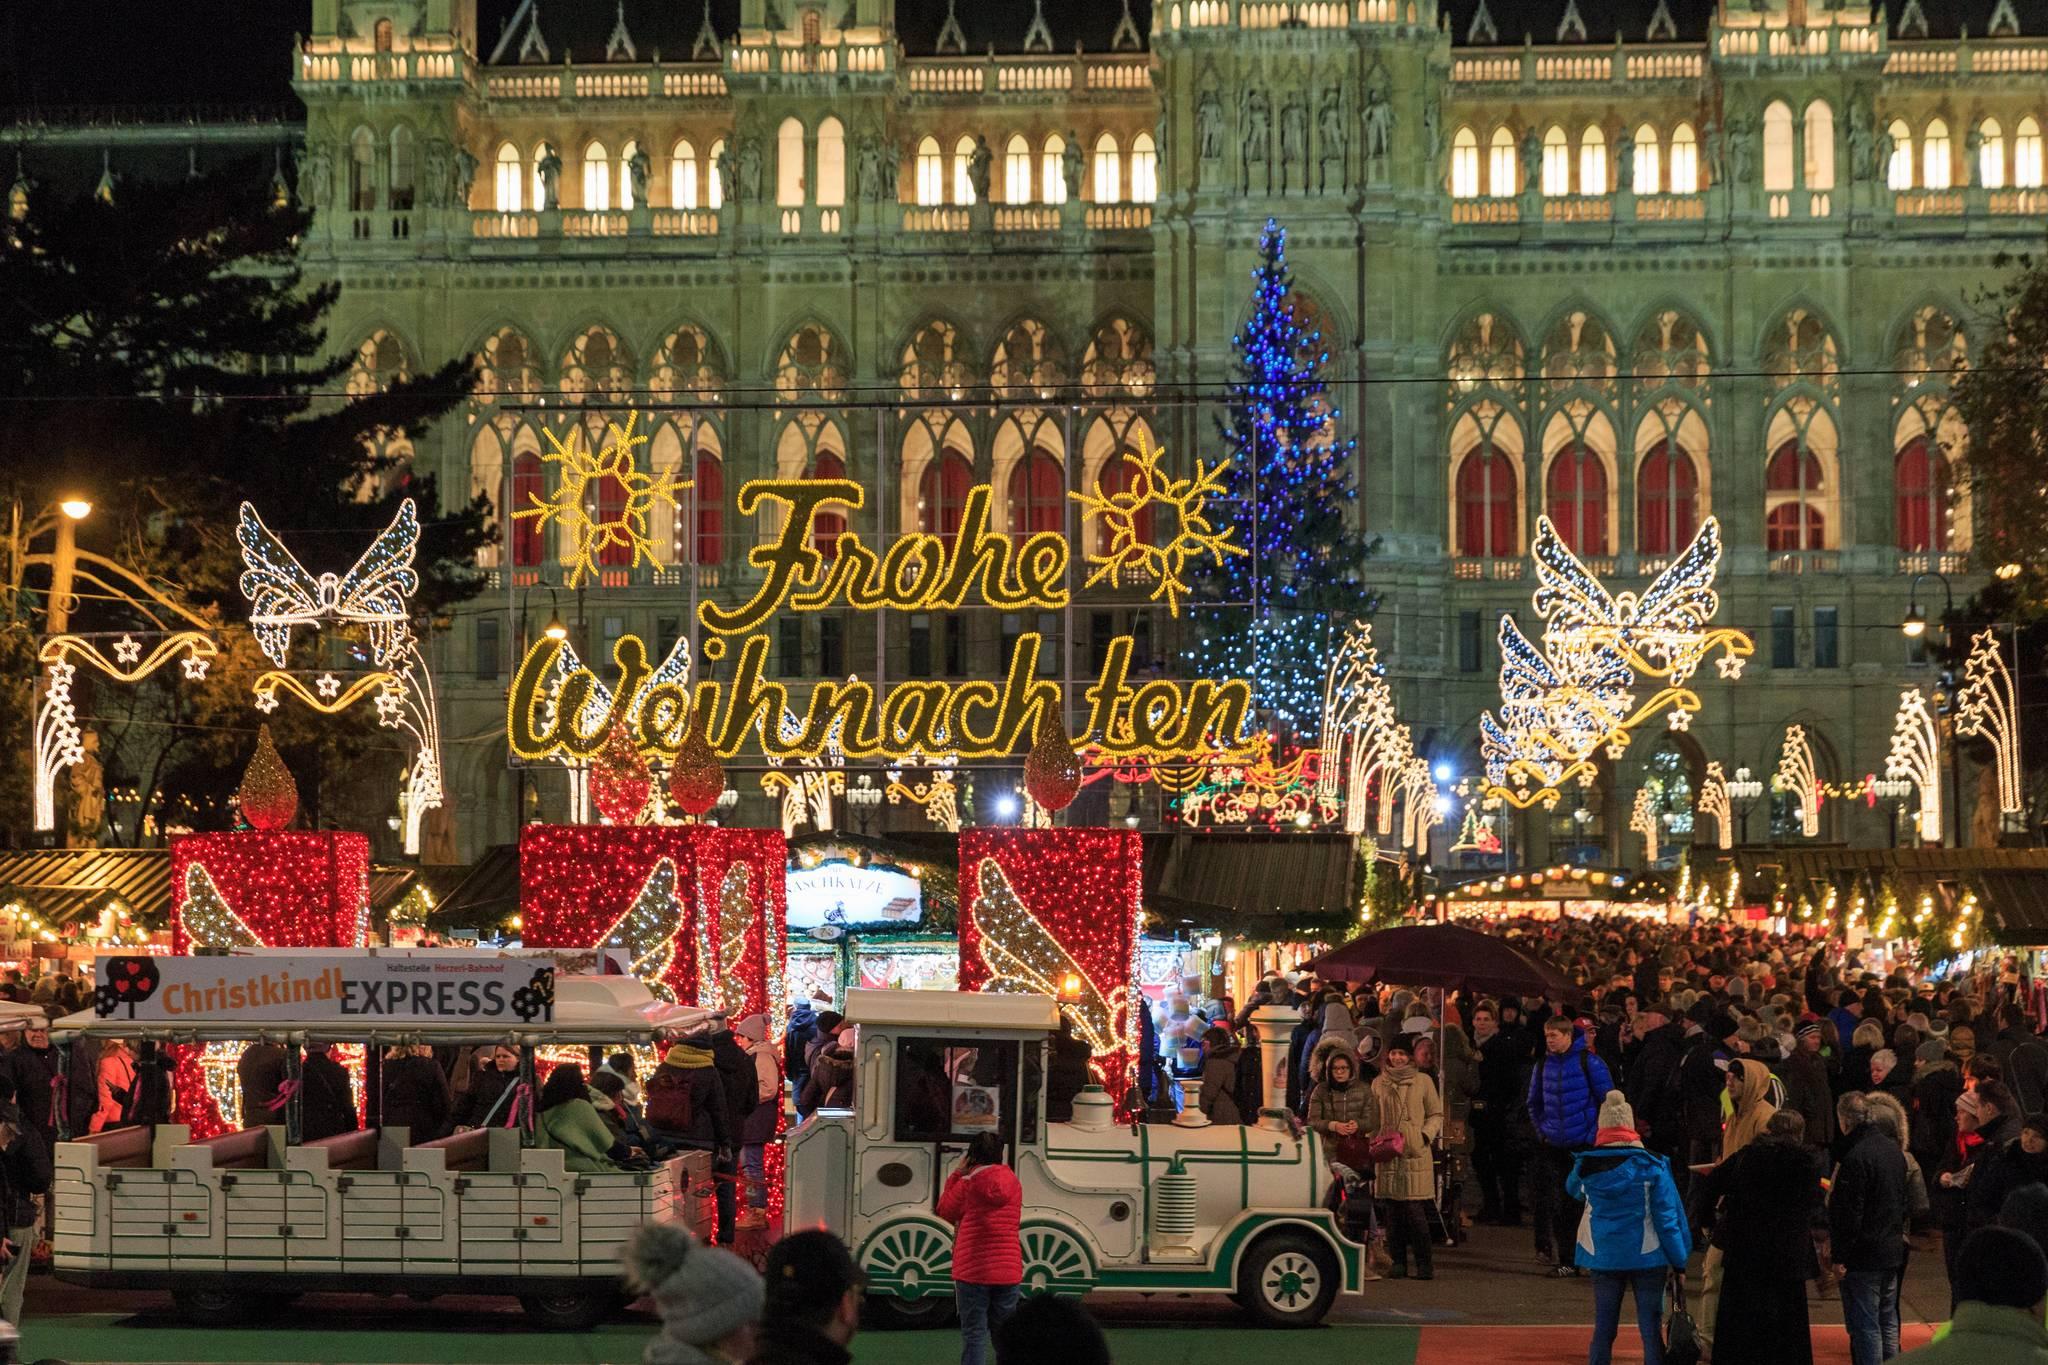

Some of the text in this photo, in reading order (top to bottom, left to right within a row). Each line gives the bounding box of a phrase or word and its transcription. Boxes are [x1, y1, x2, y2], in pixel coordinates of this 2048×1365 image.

[697, 479, 1070, 634] Frohe
[507, 632, 1256, 759] Weihnachten
[162, 967, 347, 1015] Christkindl
[387, 963, 431, 973] Haltestelle
[340, 980, 505, 1016] EXPRESS
